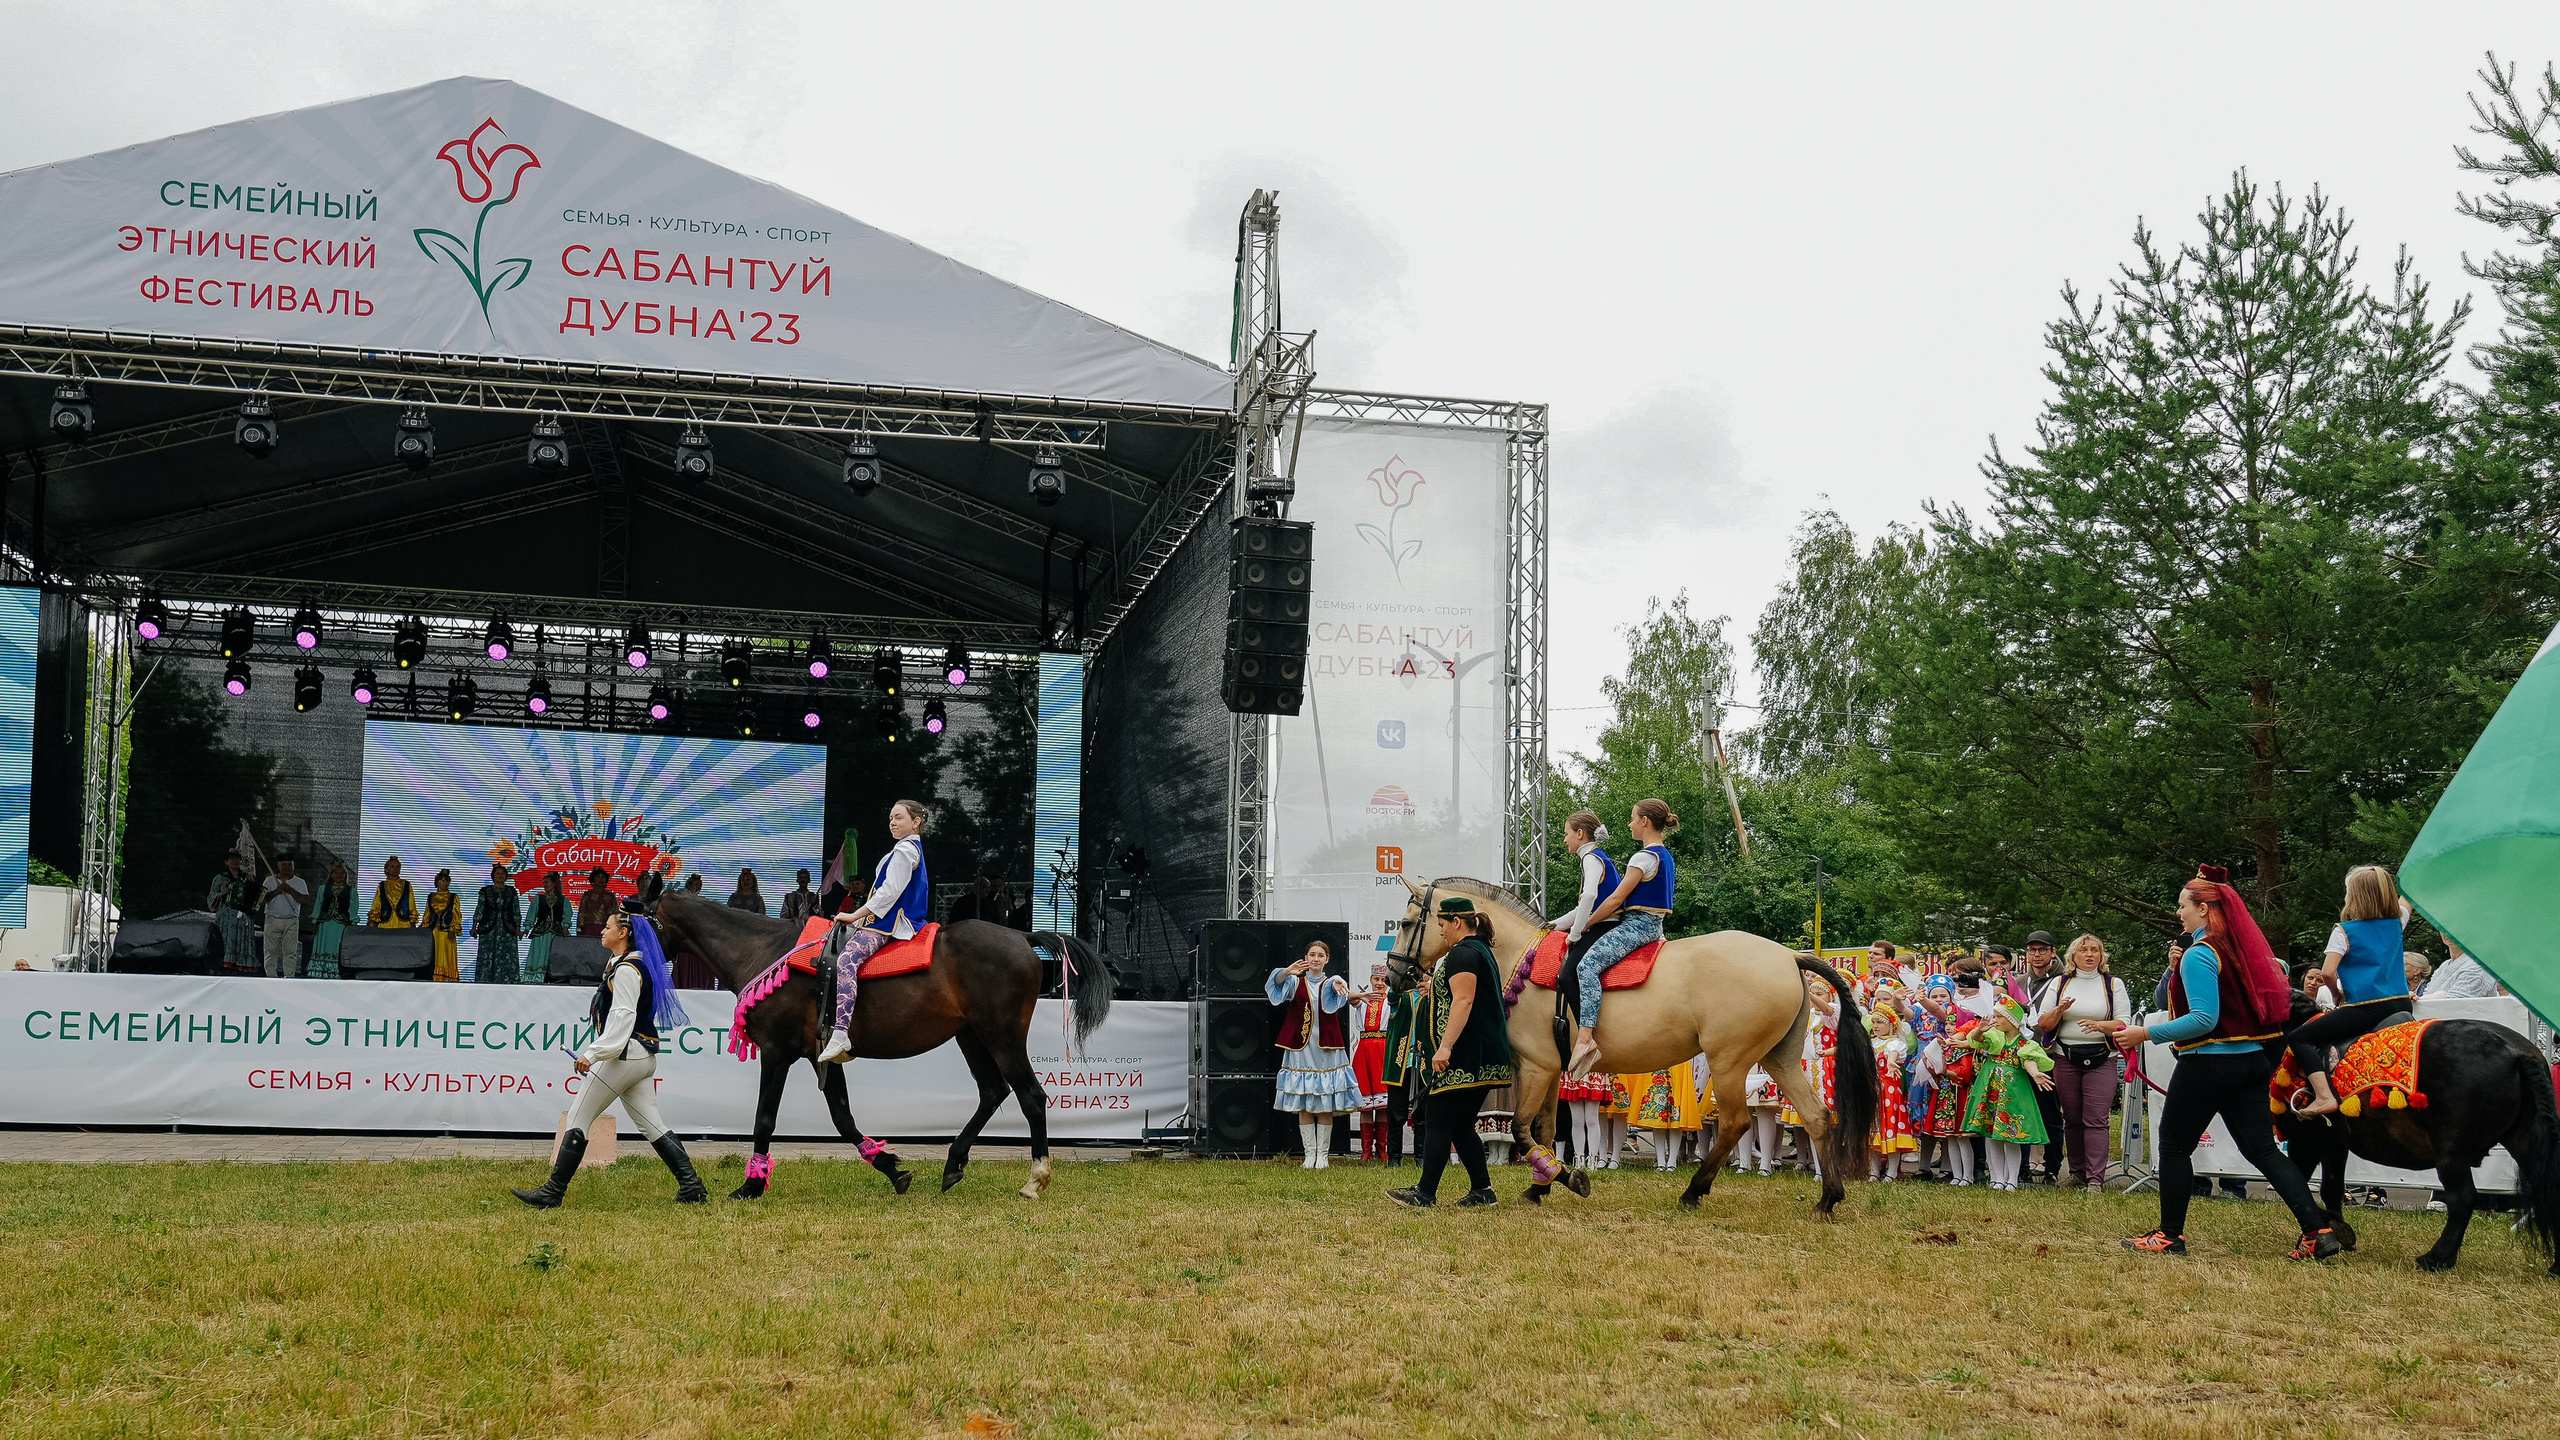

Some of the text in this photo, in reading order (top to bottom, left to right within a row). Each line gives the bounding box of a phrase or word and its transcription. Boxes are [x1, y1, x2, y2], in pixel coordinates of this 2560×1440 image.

[160, 180, 378, 221] СЕМЕЙНЫЙ
[563, 209, 832, 244] СЕМЬЯ КУЛЬТУРА СПОРТ
[117, 225, 376, 269] ЭТНИЧЕСКИЙ
[561, 244, 831, 297] САБАНТУЙ
[140, 275, 375, 317] ФЕСТИВАЛЬ
[559, 297, 801, 345] ДУБНА'23
[1315, 599, 1474, 616] СЕМЬЯ КУЛЬТУРА СПОРТ
[1315, 622, 1474, 649] САБАНТУЙ
[1314, 655, 1457, 681] ДУБНА'23
[1381, 728, 1401, 742] VK
[1365, 807, 1416, 816] ВОСТОК FM
[542, 843, 642, 874] Сабантуй
[1379, 849, 1400, 871] it
[1375, 875, 1403, 887] park
[24, 1006, 282, 1045] СЕМЕЙНЫЙ
[304, 1015, 596, 1051] ЭТНИЧЕСКИЙ
[1068, 1056, 1108, 1064] УЛЬТУРА
[248, 1069, 536, 1094] СЕМЬЯ КУЛЬТУРА
[1046, 1094, 1130, 1109] УБНА'23
